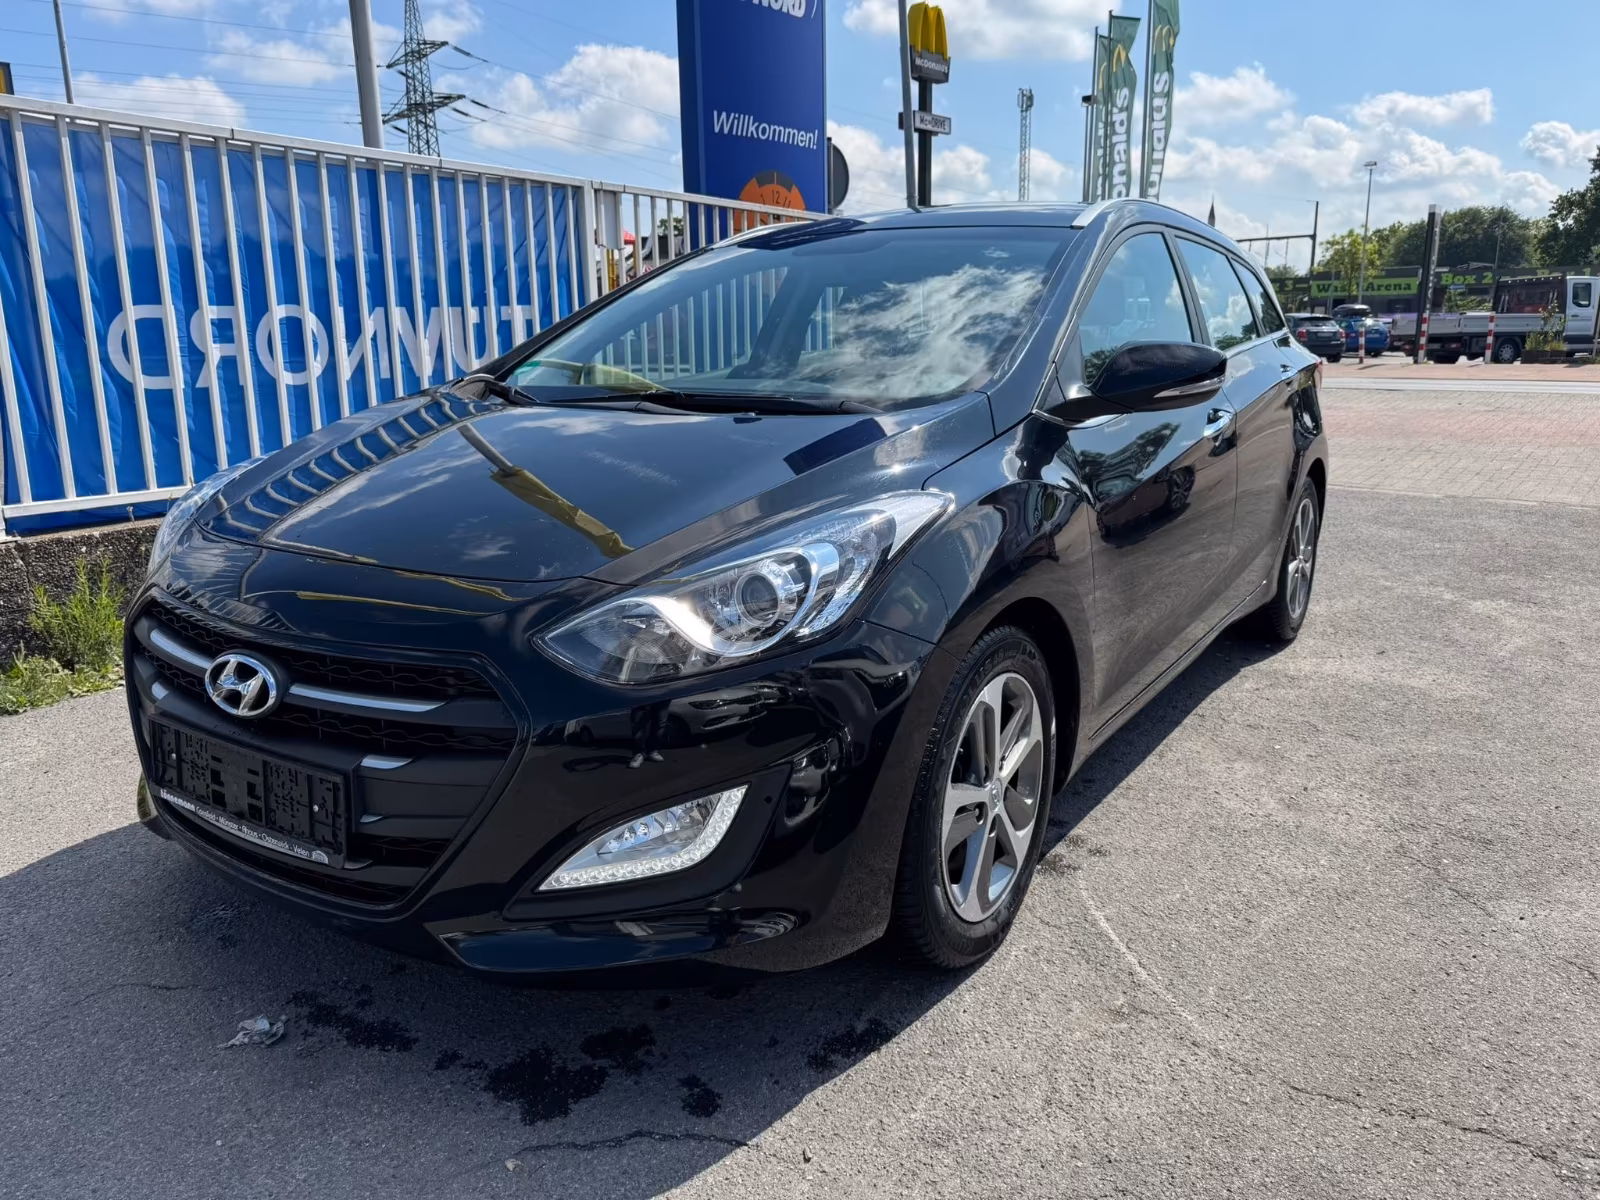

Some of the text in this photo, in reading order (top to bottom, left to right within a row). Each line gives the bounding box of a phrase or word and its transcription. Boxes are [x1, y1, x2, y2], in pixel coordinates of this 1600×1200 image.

[713, 110, 818, 150] Willkommen!
[771, 189, 781, 205] 12
[1440, 271, 1493, 285] Box 2
[1364, 281, 1412, 292] Arena
[292, 843, 310, 858] Velen
